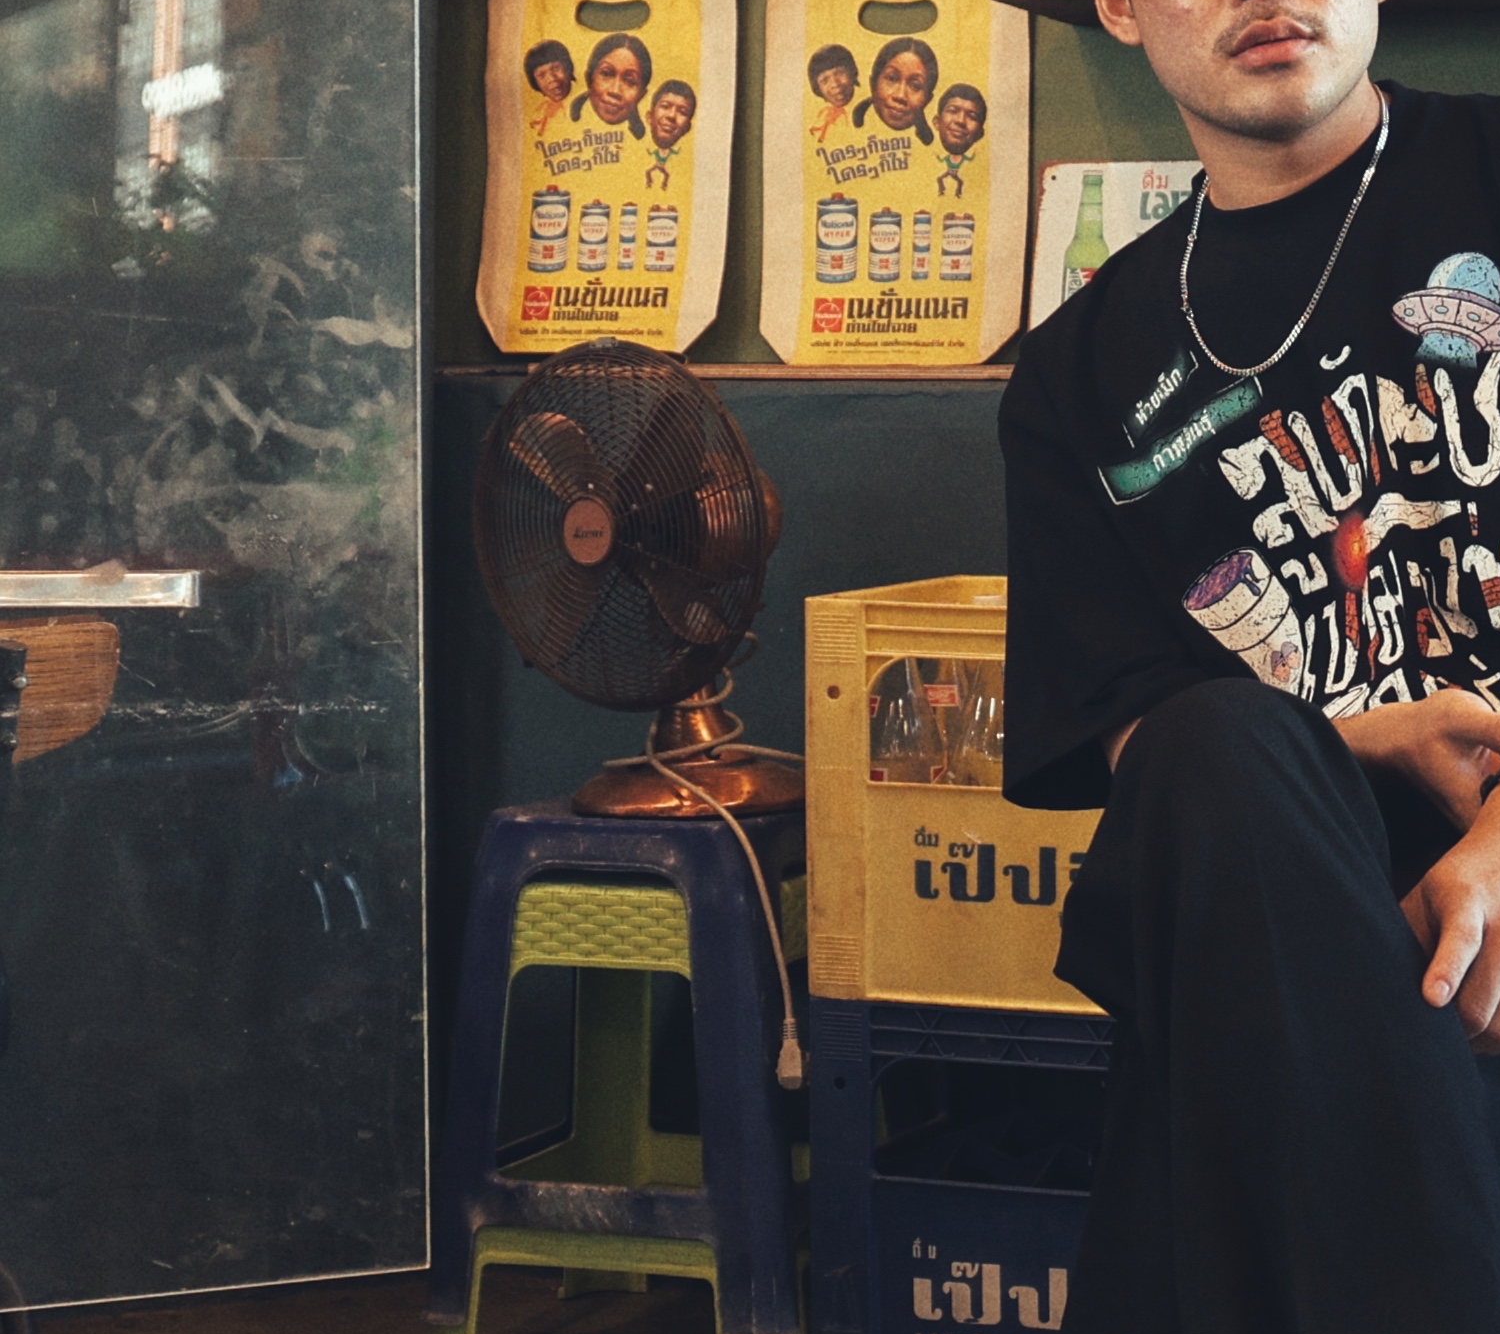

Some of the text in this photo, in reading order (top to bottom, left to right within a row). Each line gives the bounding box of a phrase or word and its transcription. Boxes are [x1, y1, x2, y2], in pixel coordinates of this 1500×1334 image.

[554, 277, 669, 307] เนชั่นแนล
[847, 288, 969, 319] เนชั่นแนล
[1135, 368, 1183, 426] ห้วยเม็ก
